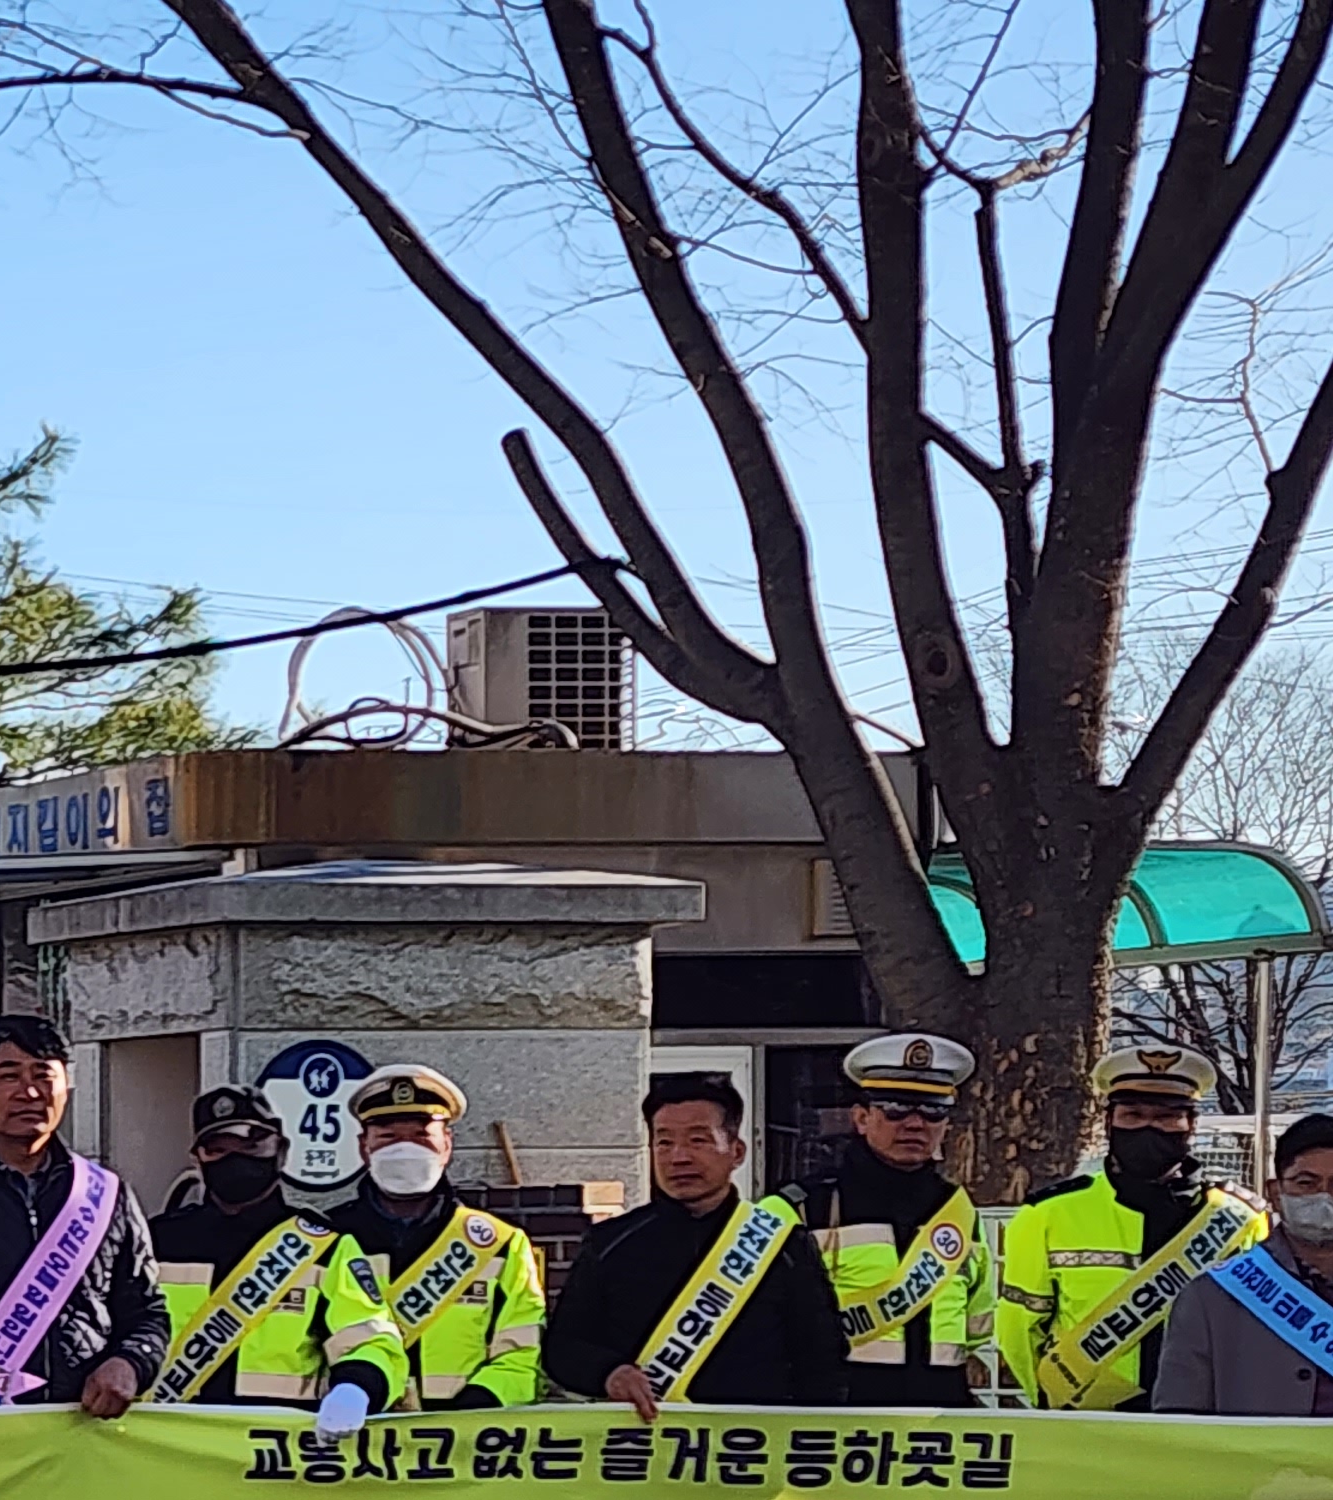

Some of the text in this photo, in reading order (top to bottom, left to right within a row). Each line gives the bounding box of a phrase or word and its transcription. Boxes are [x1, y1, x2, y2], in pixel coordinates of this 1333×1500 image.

[145, 776, 171, 837] 집
[299, 1103, 342, 1143] 45
[470, 1224, 493, 1242] 30
[936, 1230, 959, 1255] 30
[231, 1232, 313, 1316] 안전한
[396, 1240, 476, 1325] 안전한
[877, 1250, 946, 1323] 안전한
[1080, 1262, 1191, 1363] 등하교길
[244, 1427, 1014, 1488] 교통사고 없는 즐거운 등하굣길
